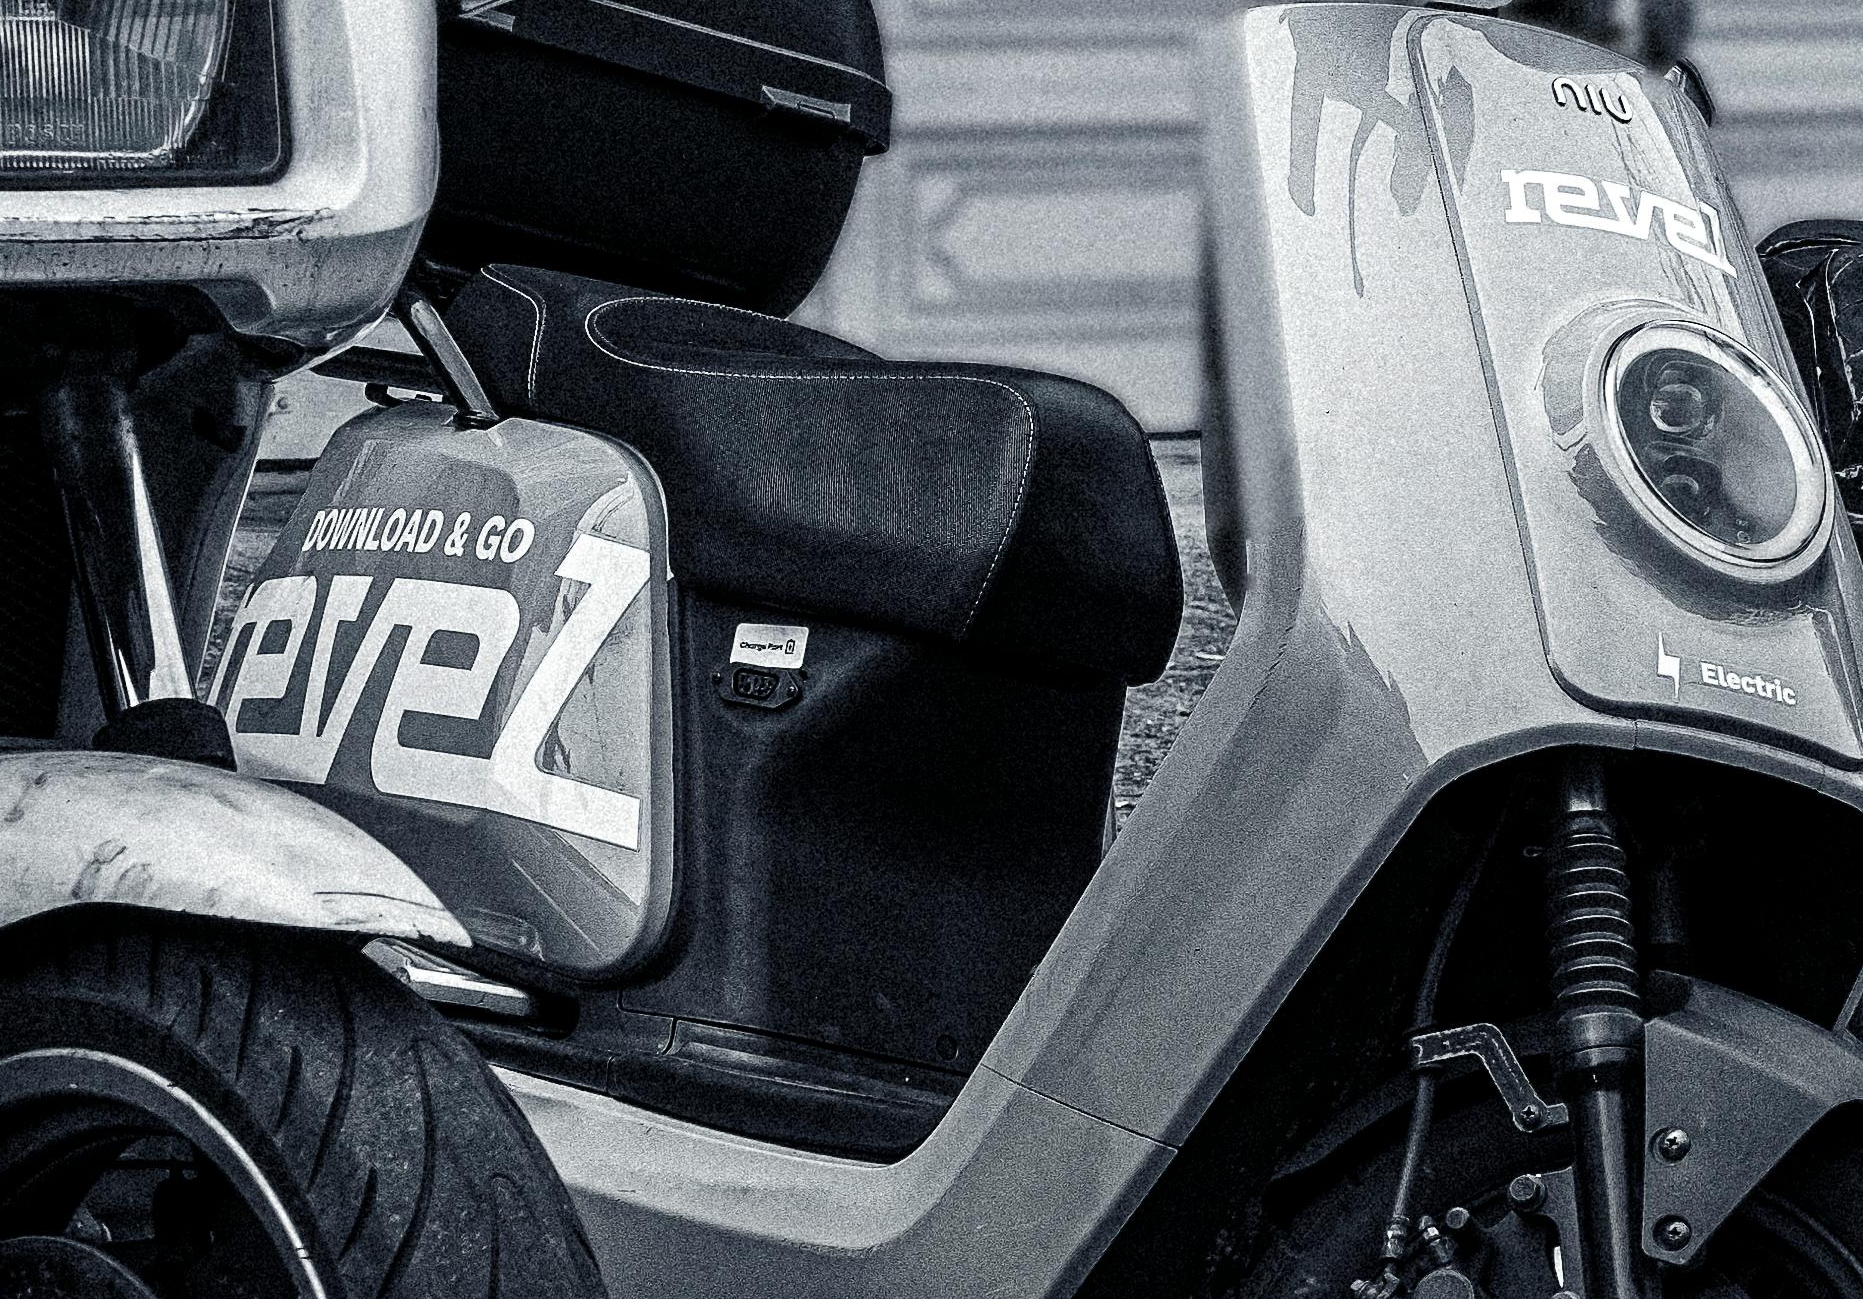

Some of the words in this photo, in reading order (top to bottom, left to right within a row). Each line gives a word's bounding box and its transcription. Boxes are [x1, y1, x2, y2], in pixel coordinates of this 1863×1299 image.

[1500, 169, 1738, 279] revel
[301, 507, 445, 554] DOWNLOAD
[443, 511, 472, 557] &
[475, 514, 536, 564] GO
[739, 641, 767, 652] Charge
[767, 642, 784, 651] Port
[1700, 661, 1797, 706] Electric
